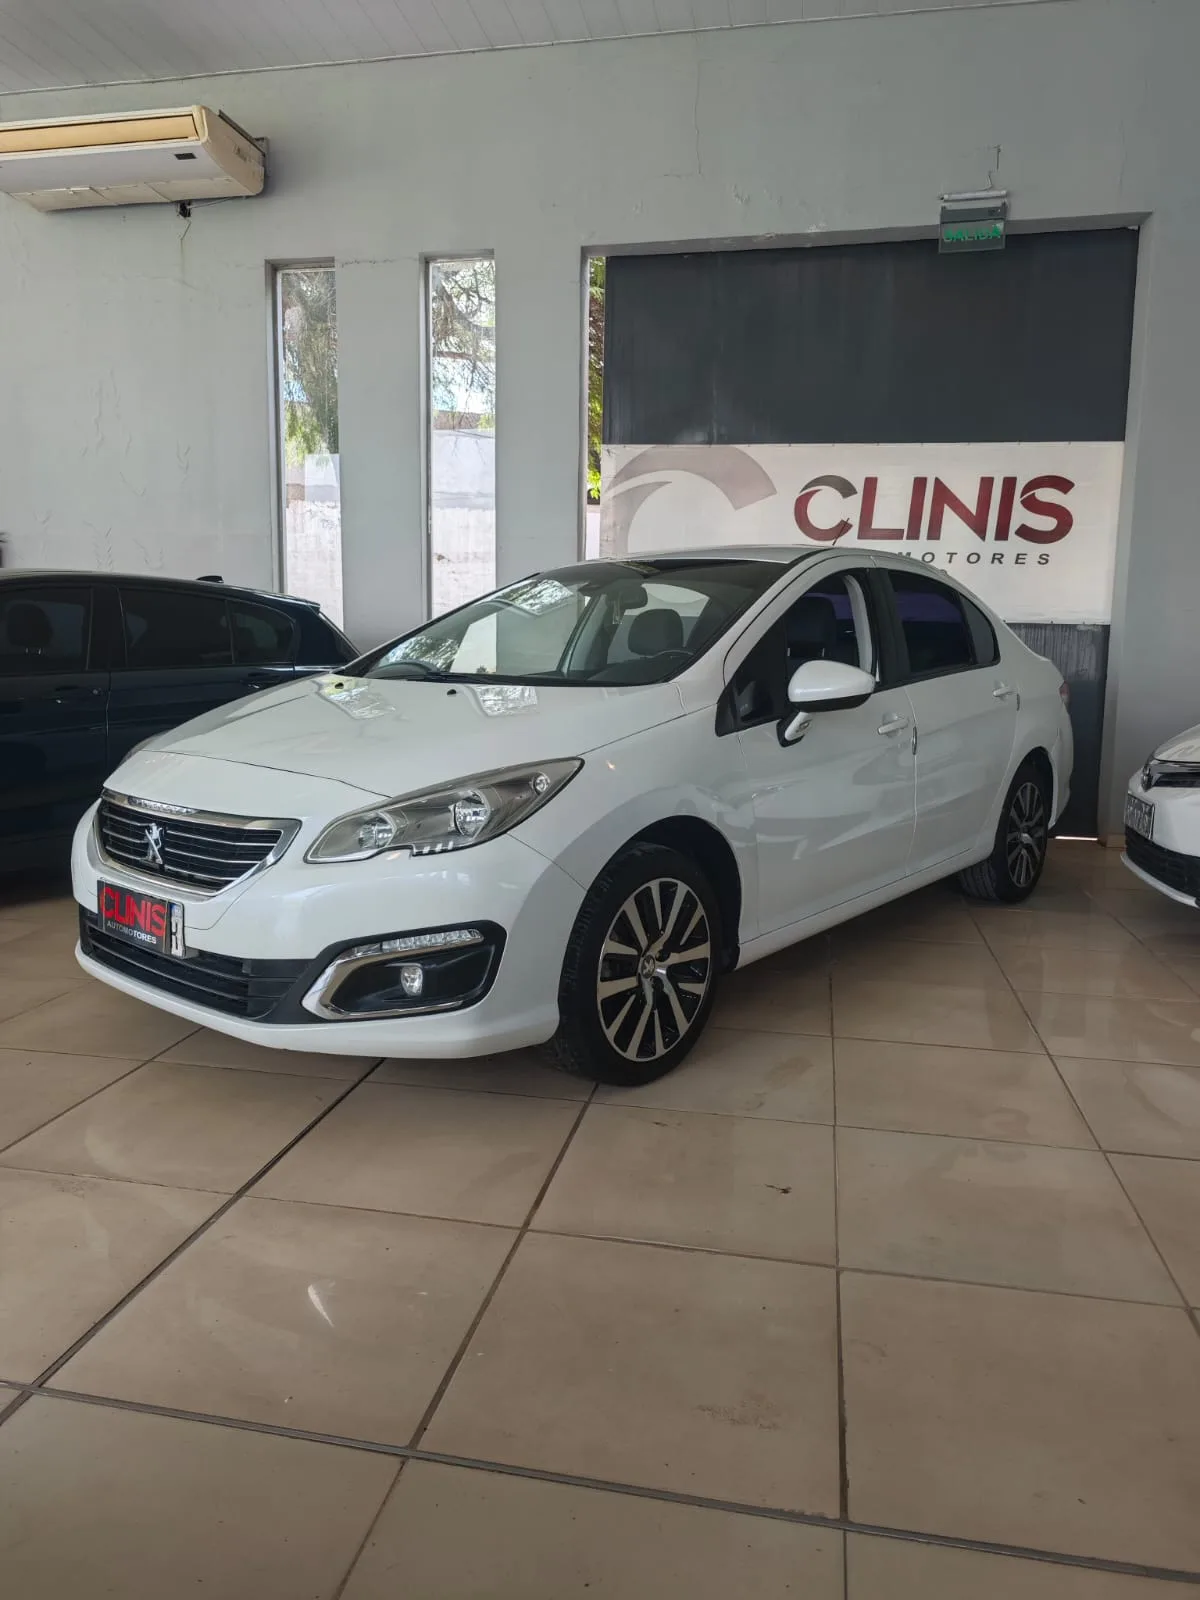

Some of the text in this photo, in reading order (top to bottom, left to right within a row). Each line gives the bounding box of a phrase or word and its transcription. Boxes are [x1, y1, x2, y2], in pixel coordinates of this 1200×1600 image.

[944, 223, 1002, 242] SALIDA
[794, 475, 1075, 544] CLINIS
[99, 886, 166, 937] CLINIS
[106, 920, 157, 945] AUTOMOTORES
